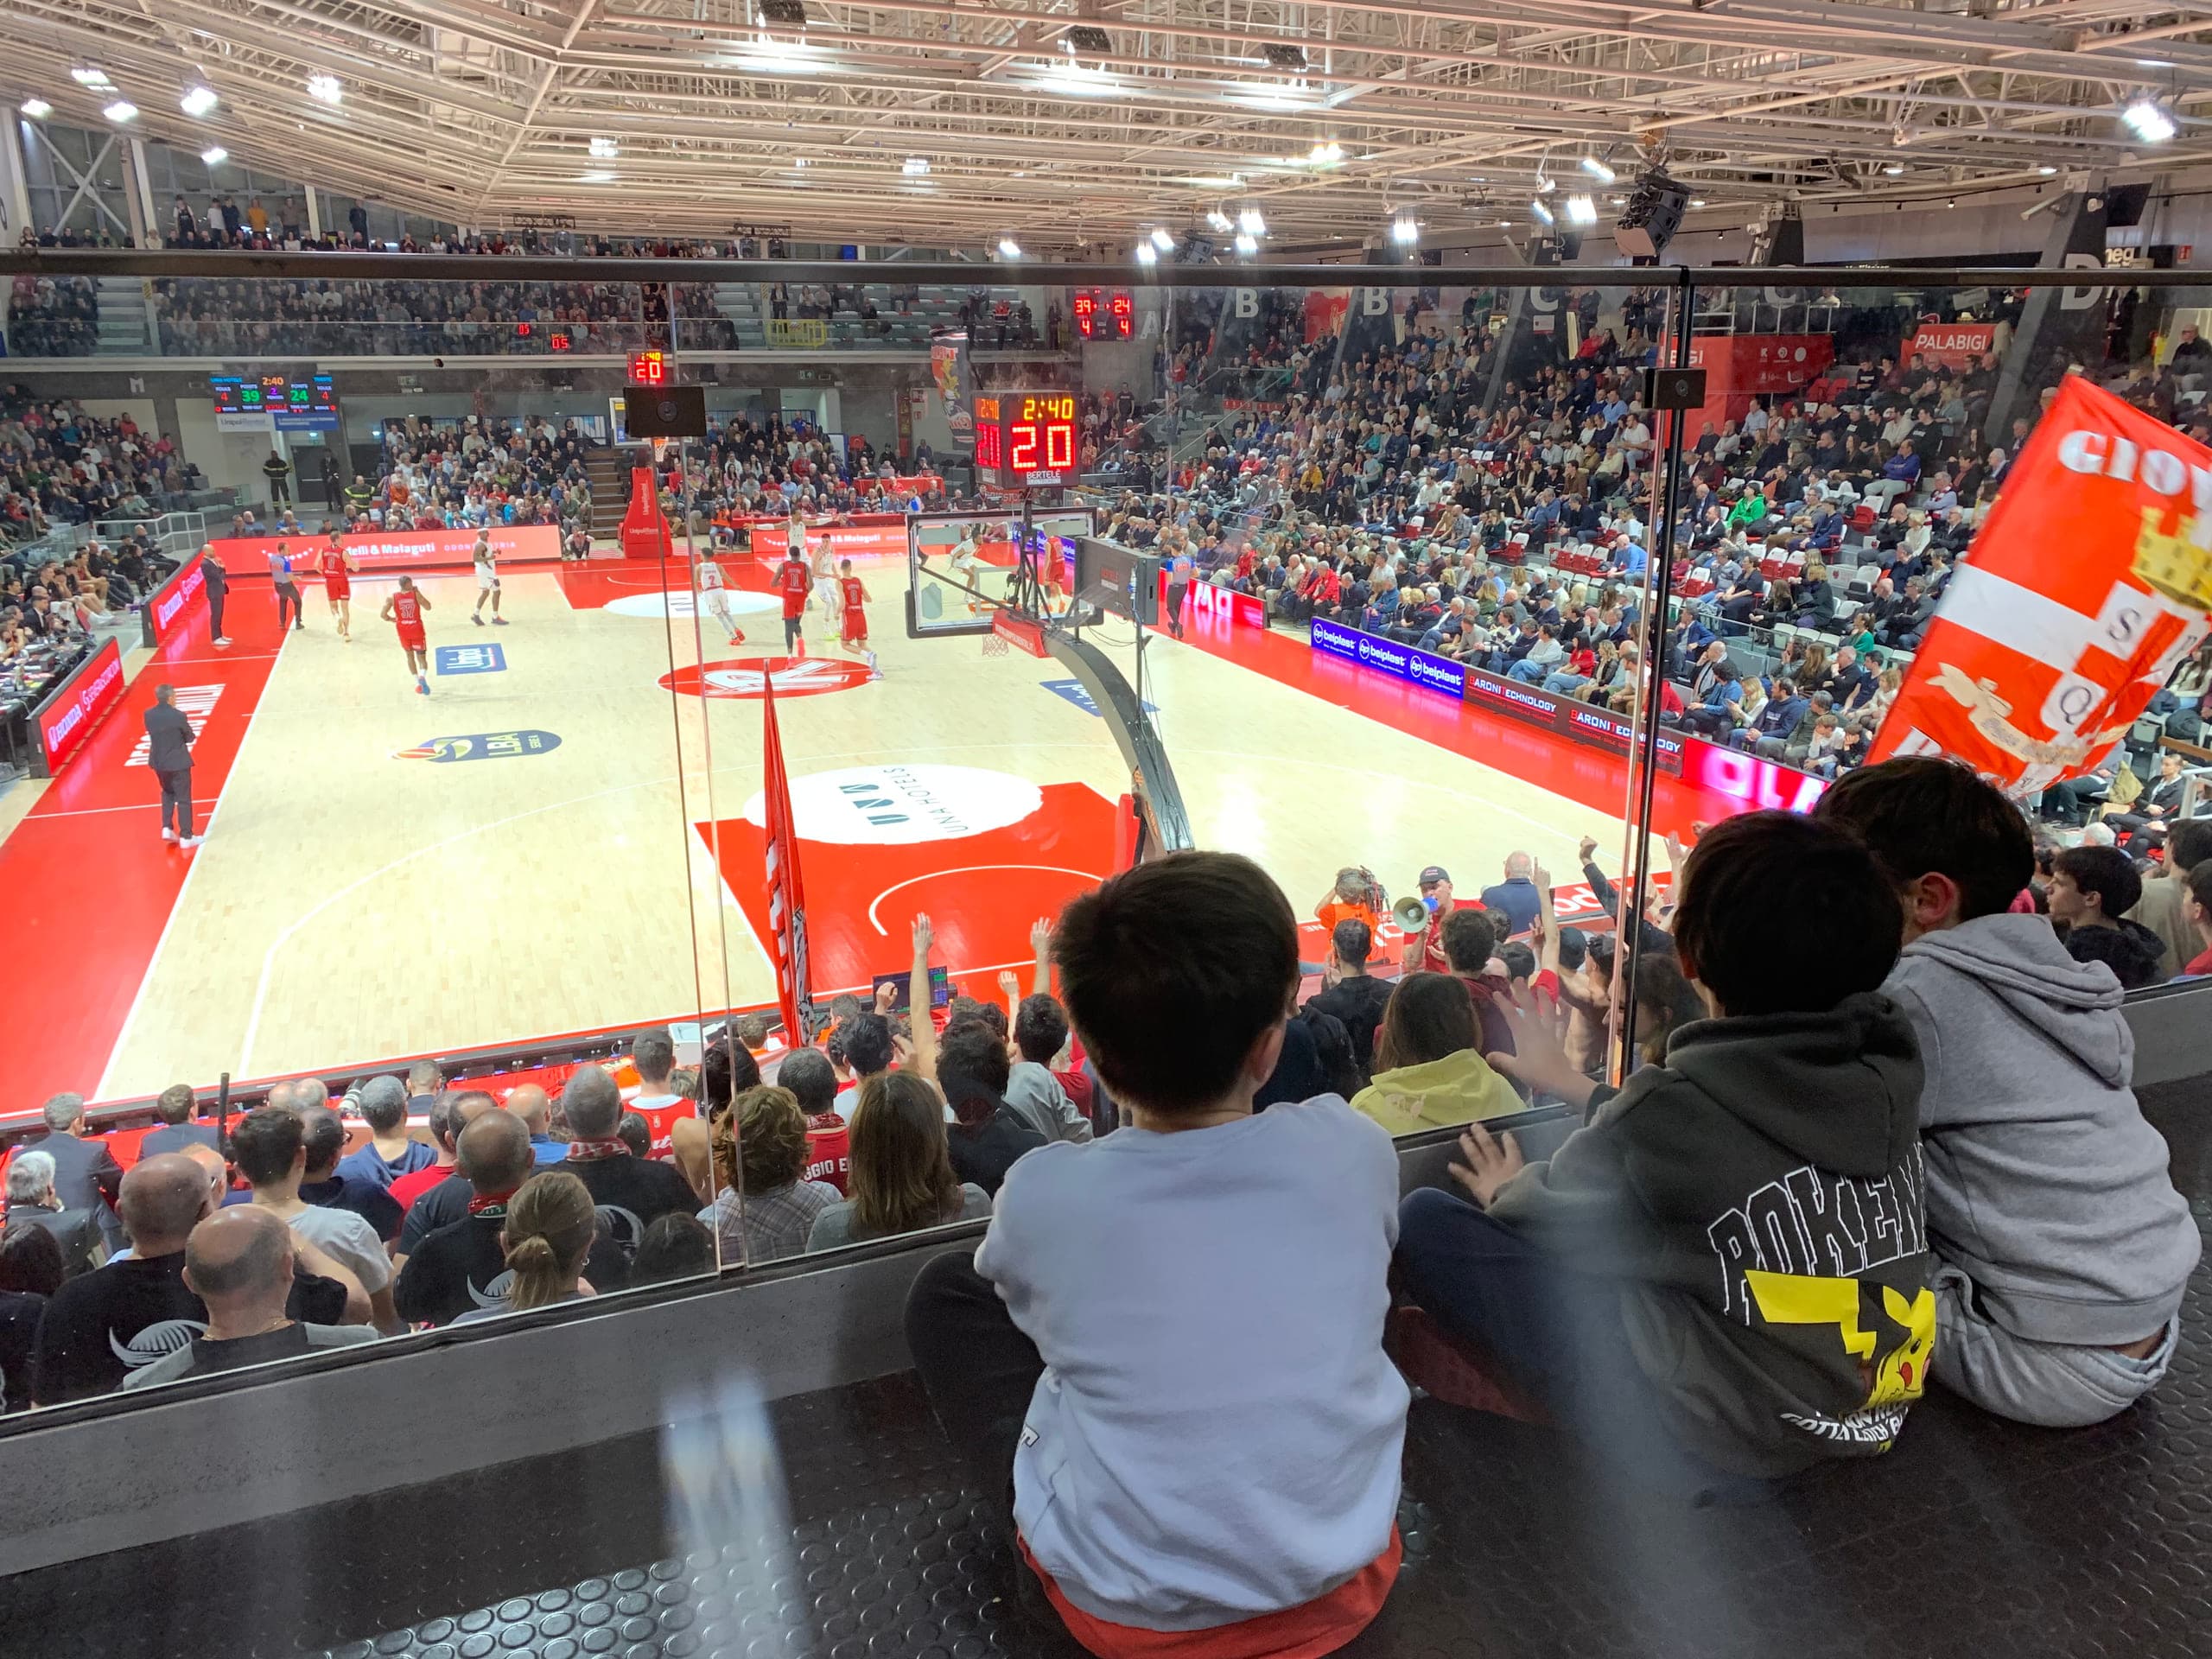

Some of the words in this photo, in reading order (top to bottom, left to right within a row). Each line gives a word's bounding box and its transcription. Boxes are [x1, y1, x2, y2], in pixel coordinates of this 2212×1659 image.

[1075, 299, 1090, 313] 39
[1114, 299, 1129, 313] 24
[1236, 288, 1259, 318] B
[1363, 287, 1389, 315] B
[1082, 320, 1090, 334] 4
[1120, 320, 1128, 334] 4
[1915, 334, 1986, 351] PALABIGI
[262, 377, 283, 385] 2:40
[220, 392, 228, 401] 4
[242, 391, 260, 402] 39
[290, 391, 309, 402] 24
[321, 391, 329, 400] 4
[981, 399, 1000, 420] 2:40
[1024, 398, 1073, 420] 2:40
[976, 423, 1001, 467] 20
[1012, 426, 1071, 468] 20
[382, 543, 435, 556] Malaguti
[709, 575, 715, 586] 2
[2106, 607, 2141, 643] S
[2061, 685, 2092, 726] Q
[486, 733, 523, 755] LBA
